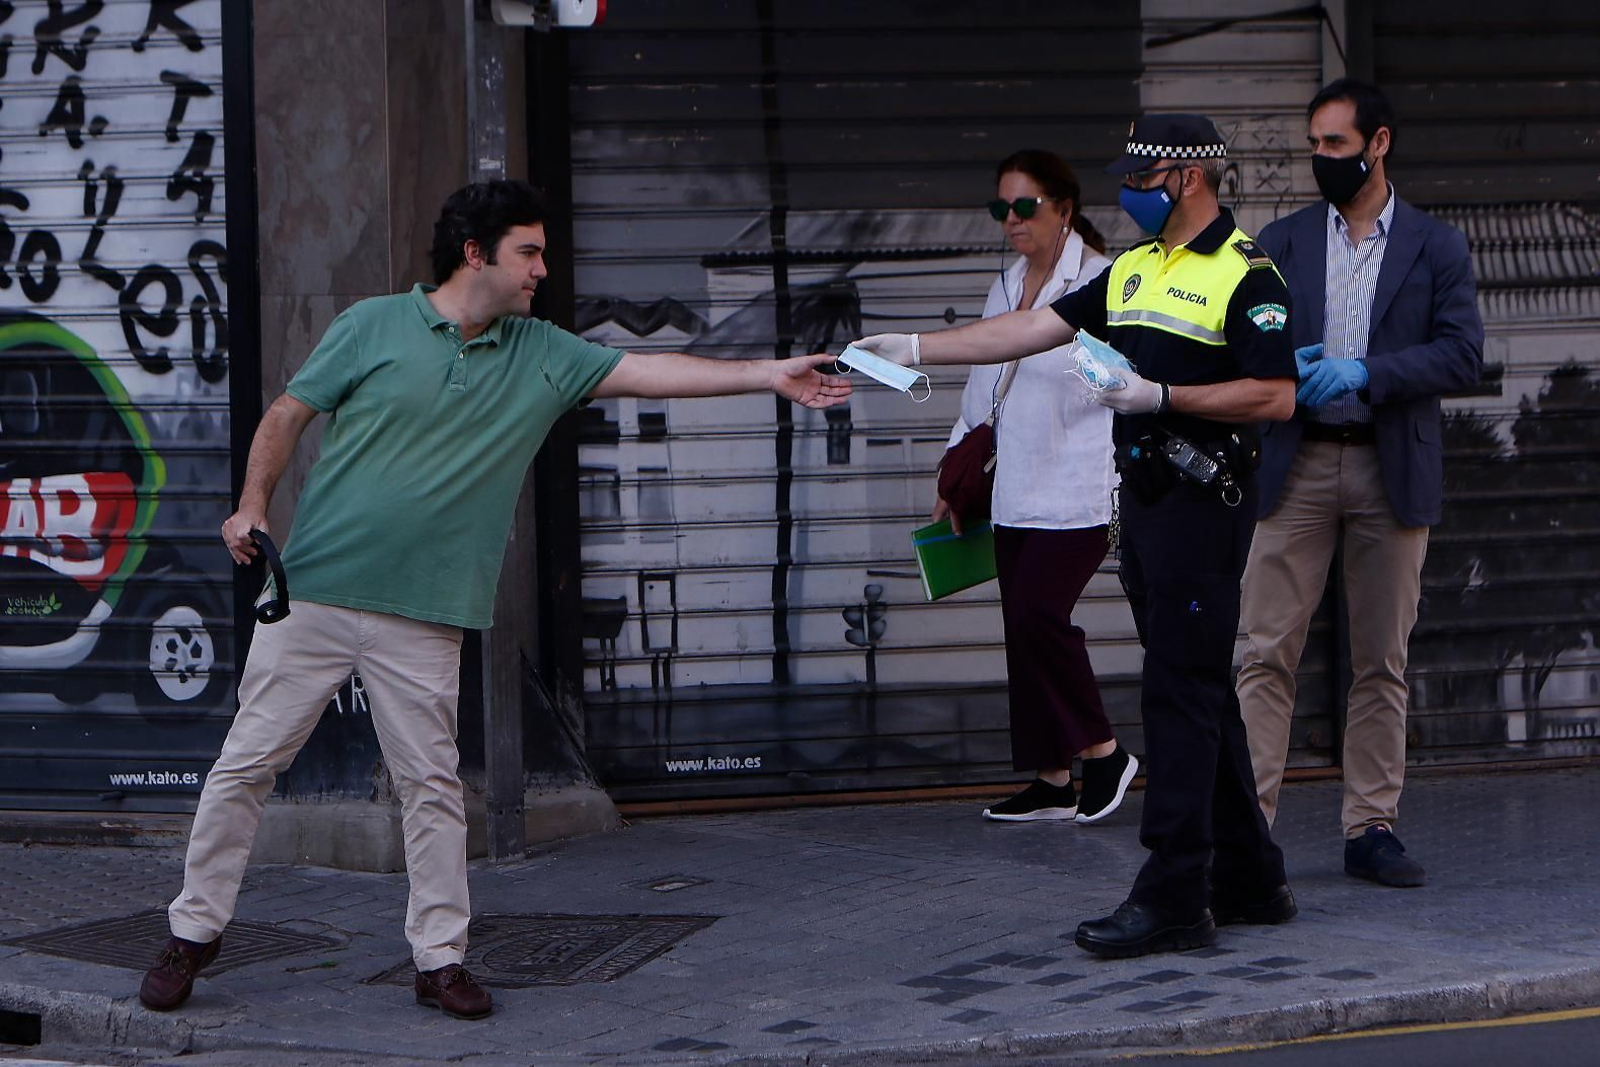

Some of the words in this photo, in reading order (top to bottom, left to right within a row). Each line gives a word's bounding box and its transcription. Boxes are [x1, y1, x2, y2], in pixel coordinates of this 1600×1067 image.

[1166, 286, 1208, 307] POLICIA
[665, 756, 761, 772] www.kato.es
[109, 771, 199, 786] www.kato.es
